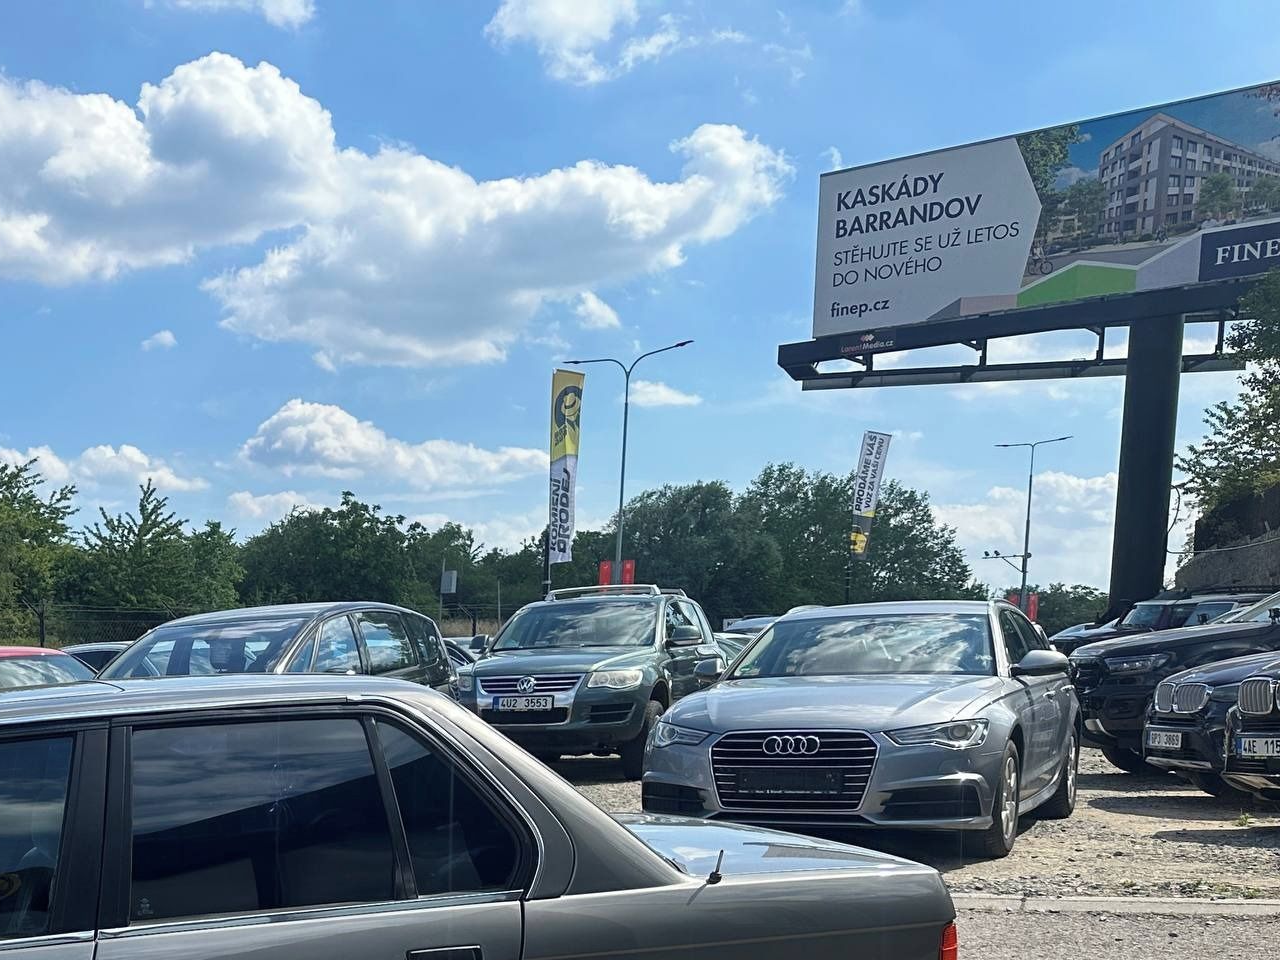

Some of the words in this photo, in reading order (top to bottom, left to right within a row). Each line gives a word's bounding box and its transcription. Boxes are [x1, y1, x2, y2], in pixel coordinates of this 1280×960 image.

[836, 172, 945, 212] KASKÁDY
[835, 194, 983, 239] BARRANDOV
[833, 239, 909, 267] STĚHUJTE
[913, 235, 933, 252] SE
[938, 227, 961, 249] UŽ
[966, 221, 1020, 245] LETOS
[1214, 238, 1280, 266] FINE
[832, 270, 859, 287] DO
[864, 256, 943, 283] NOVÉHO
[830, 299, 890, 318] finep.cz
[501, 699, 517, 708] 4U2
[524, 698, 549, 708] 3553
[1243, 740, 1257, 754] 4AE
